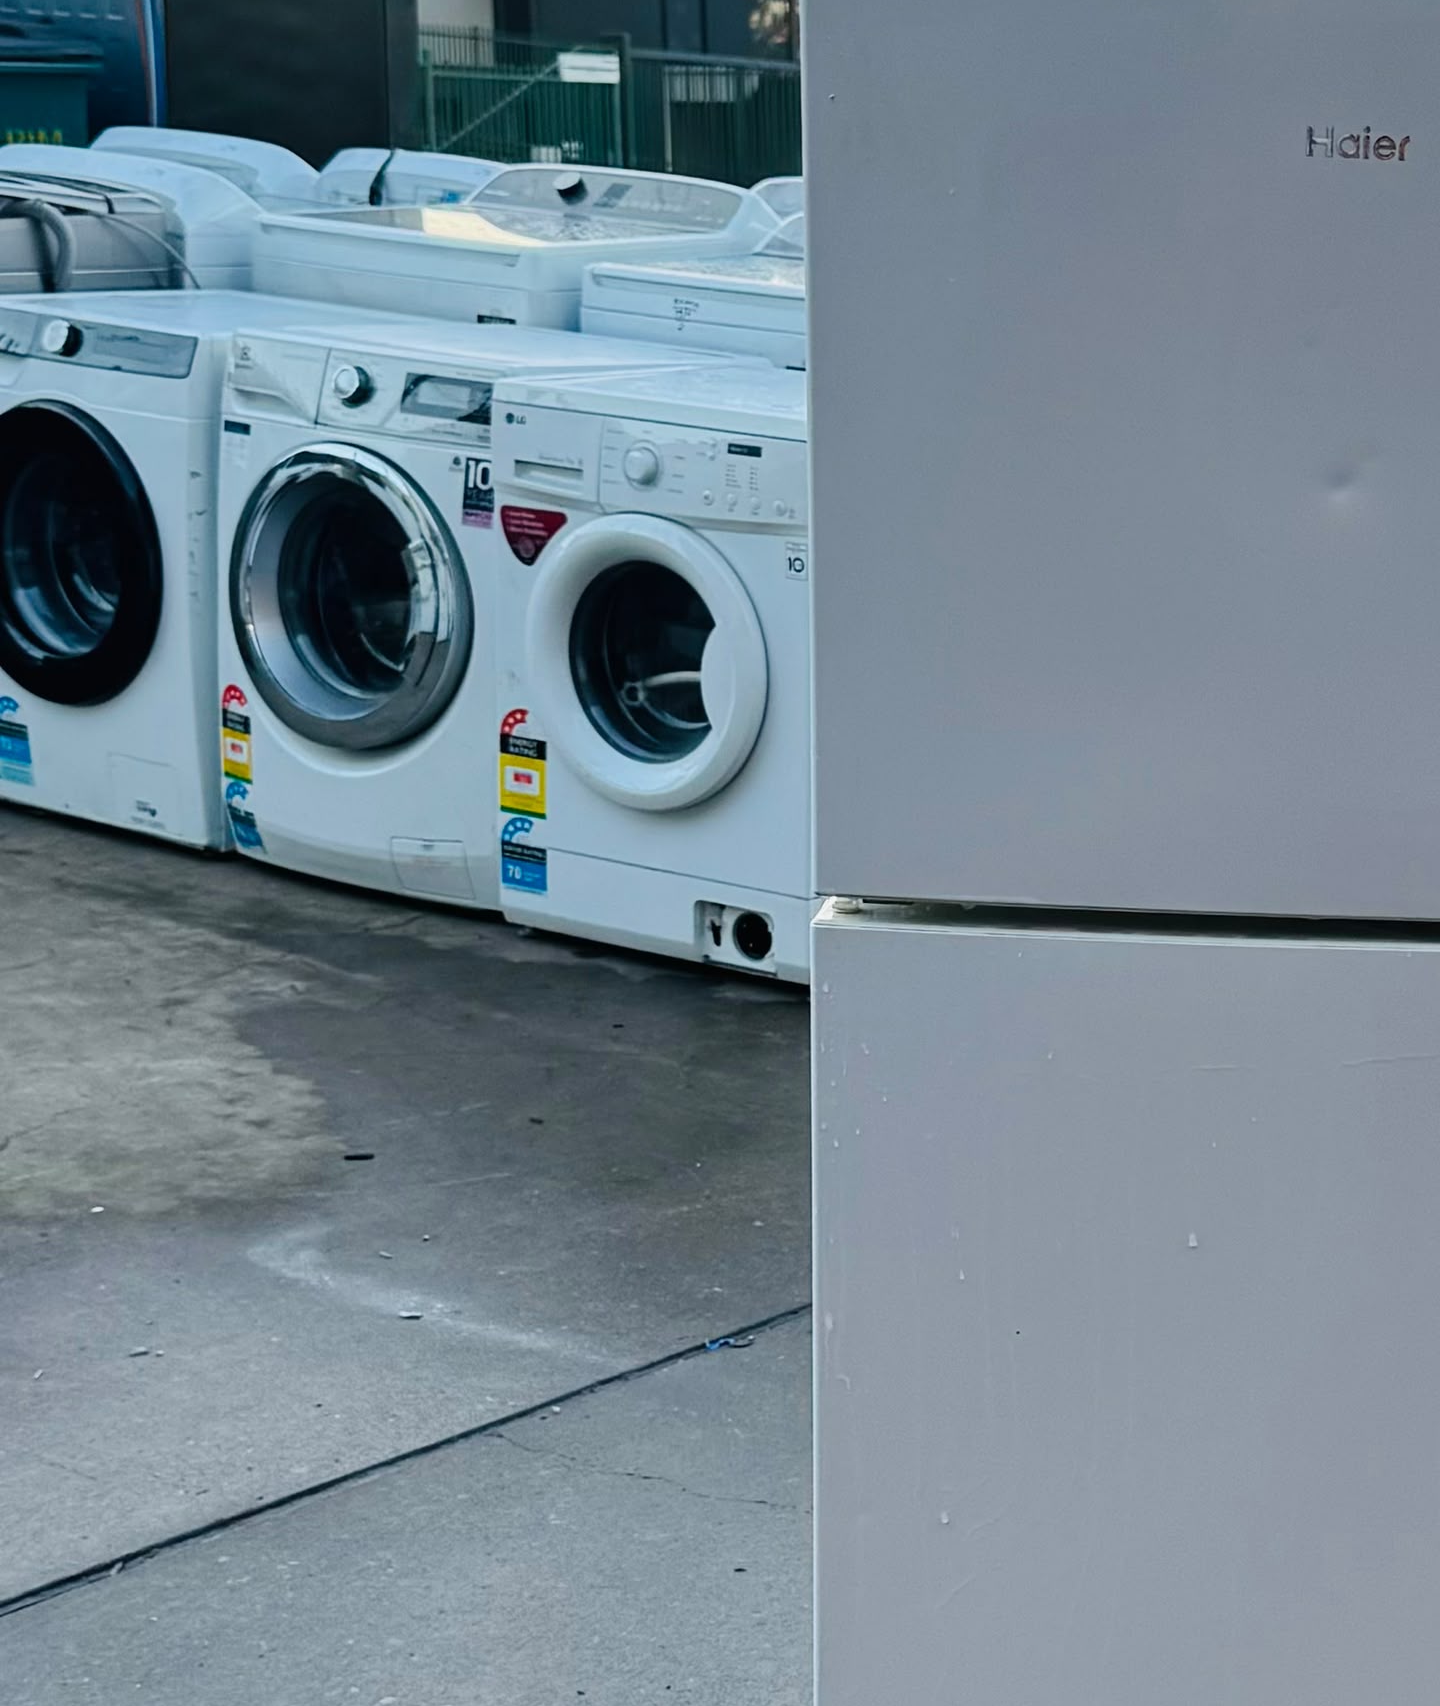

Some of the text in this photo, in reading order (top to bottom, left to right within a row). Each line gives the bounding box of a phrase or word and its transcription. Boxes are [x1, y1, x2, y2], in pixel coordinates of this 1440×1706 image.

[1306, 125, 1411, 161] Haier
[516, 415, 527, 425] LG
[468, 459, 493, 491] 10
[788, 556, 805, 573] 10
[507, 864, 522, 880] 70
